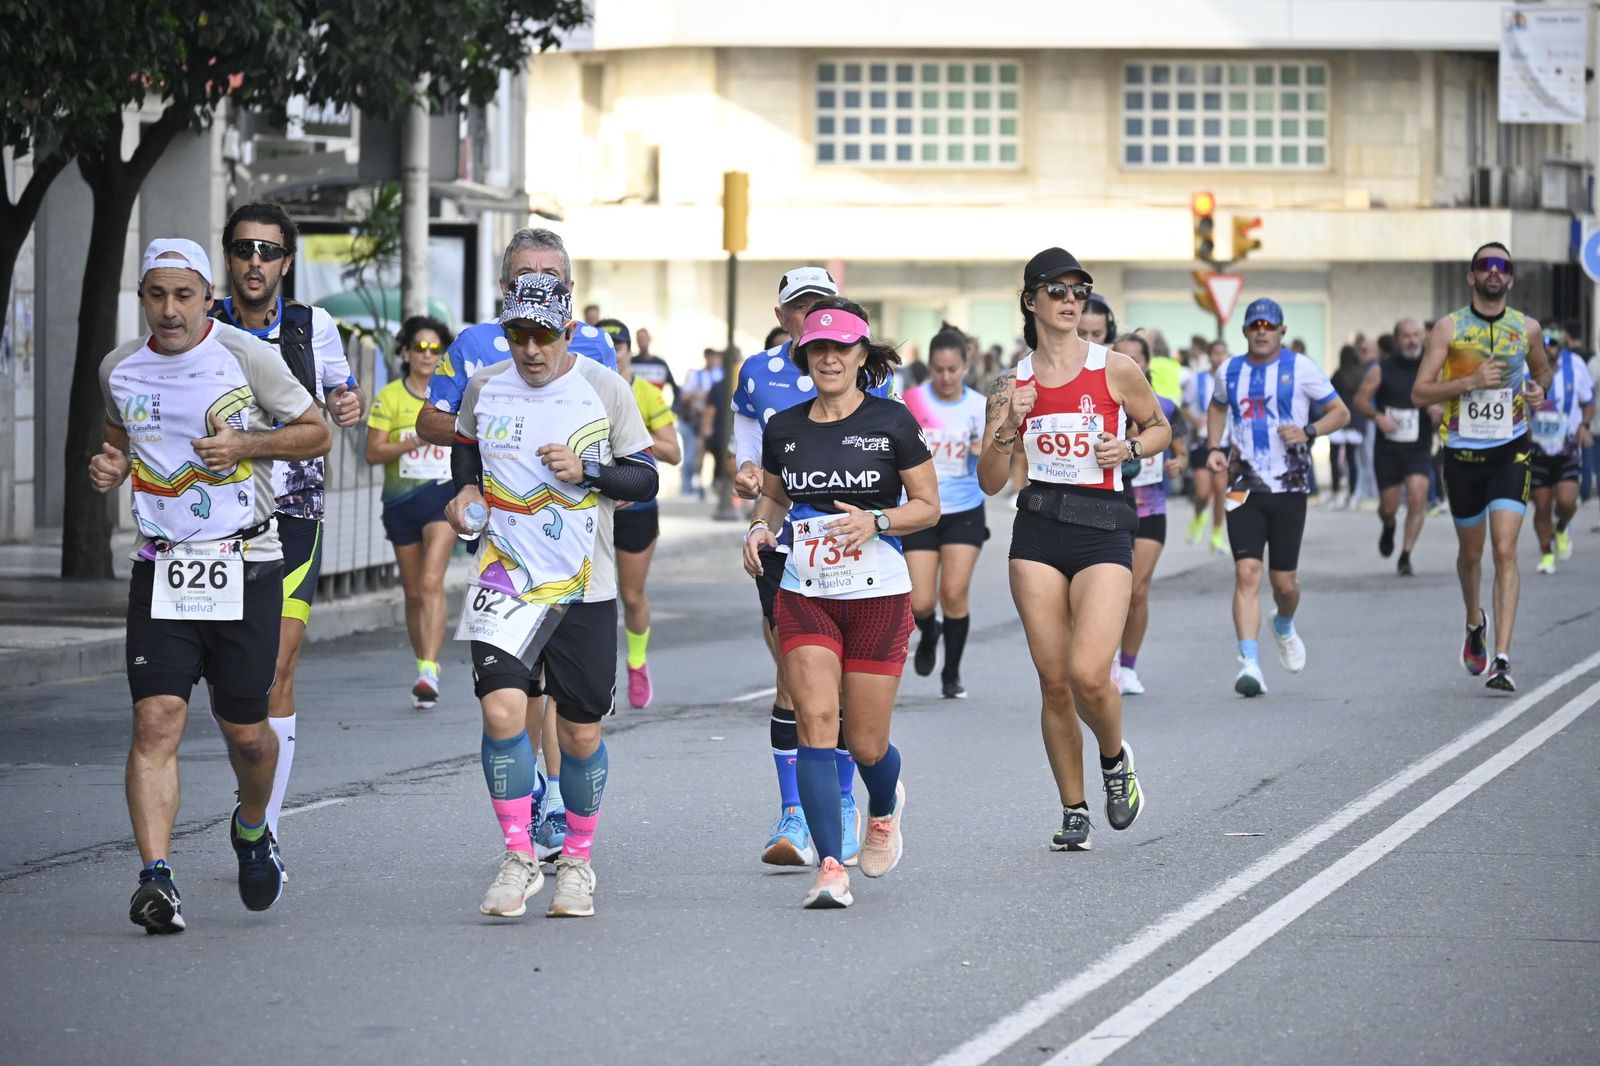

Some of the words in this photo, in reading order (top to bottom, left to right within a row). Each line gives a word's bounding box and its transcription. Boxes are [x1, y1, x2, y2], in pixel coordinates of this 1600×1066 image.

[124, 394, 149, 422] 18
[1468, 402, 1505, 420] 649
[484, 415, 512, 441] 18
[491, 441, 520, 450] CaixaBank
[930, 441, 966, 459] 712
[1036, 433, 1090, 458] 695
[787, 470, 881, 490] JUCAMP
[1045, 466, 1077, 479] Huelva
[805, 536, 863, 568] 734
[167, 560, 228, 590] 626
[818, 578, 852, 589] Huelva
[175, 602, 213, 613] Huelva
[473, 588, 528, 620] 627
